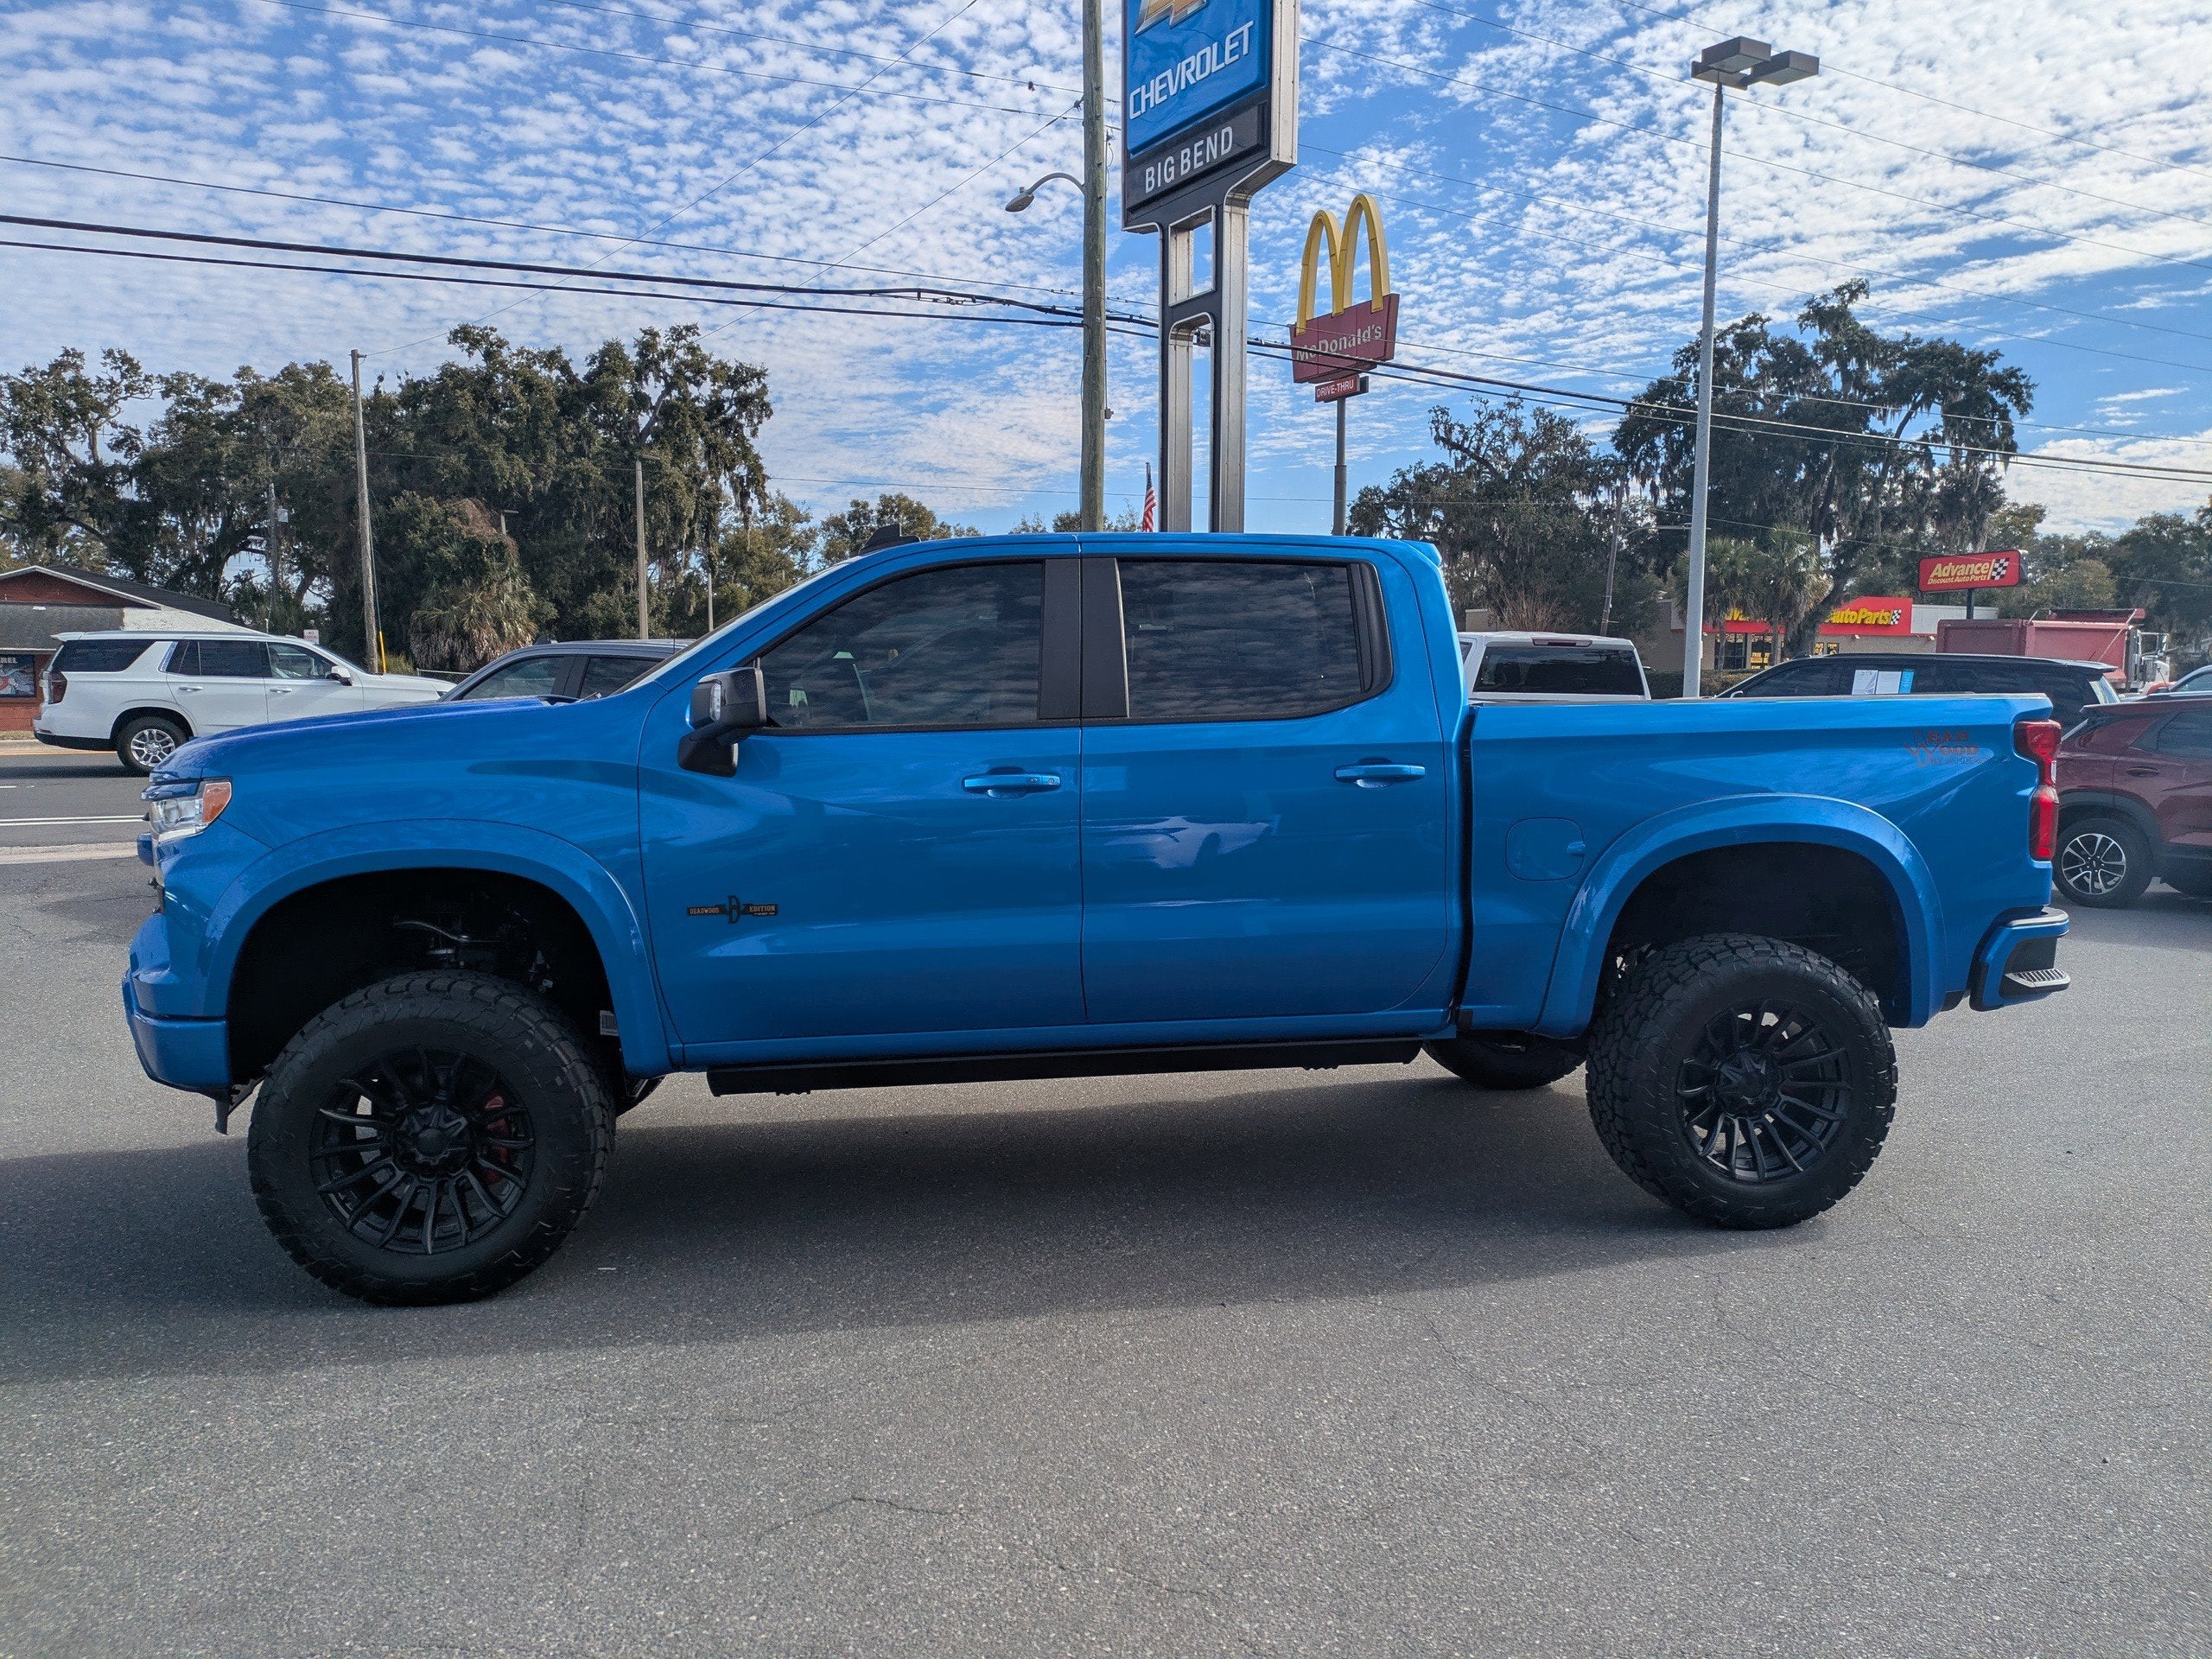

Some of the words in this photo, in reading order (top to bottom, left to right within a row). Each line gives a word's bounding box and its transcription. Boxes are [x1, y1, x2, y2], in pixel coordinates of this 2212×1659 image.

[1129, 20, 1254, 119] CHEVROLET
[1145, 155, 1175, 194] BIG
[1180, 126, 1233, 175] BEND
[1316, 378, 1354, 397] DRIVE-THRU
[1929, 562, 1990, 578] Advance
